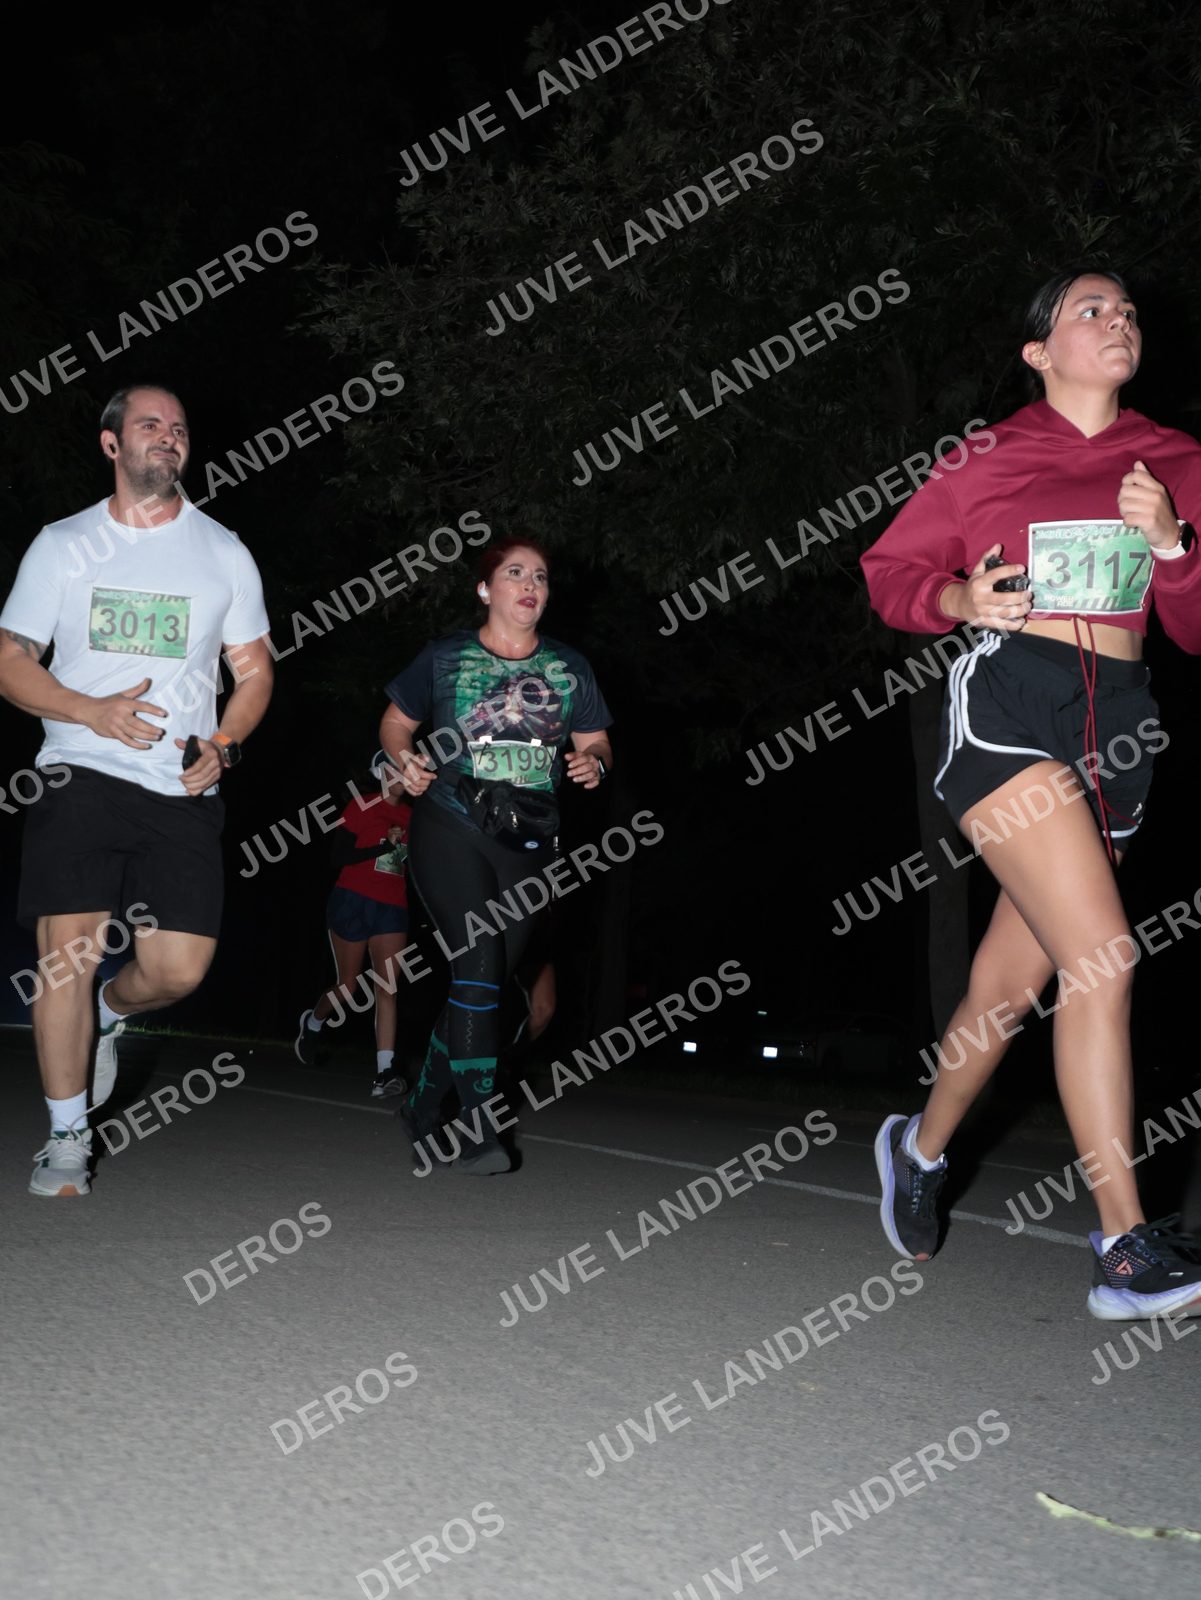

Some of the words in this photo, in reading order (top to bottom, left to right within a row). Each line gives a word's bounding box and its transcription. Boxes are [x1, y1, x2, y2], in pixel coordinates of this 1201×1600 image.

[1046, 550, 1147, 590] 3117
[98, 607, 180, 643] 3013
[483, 747, 548, 773] 3199
